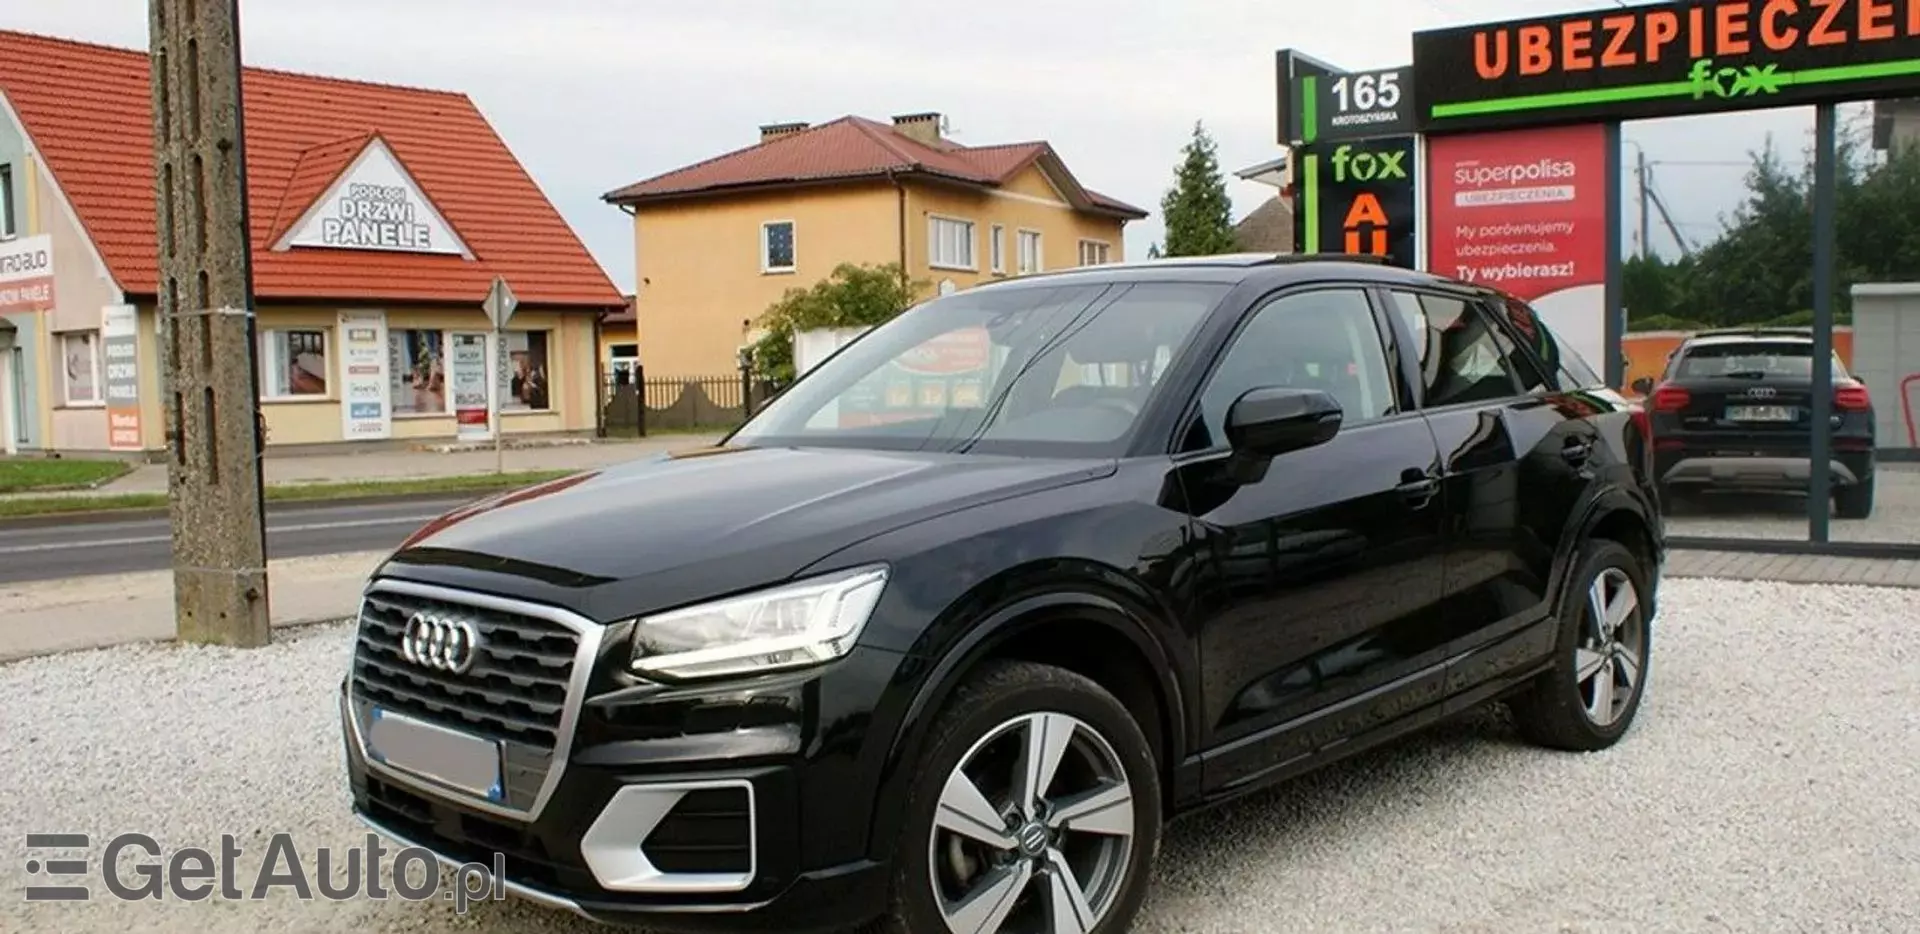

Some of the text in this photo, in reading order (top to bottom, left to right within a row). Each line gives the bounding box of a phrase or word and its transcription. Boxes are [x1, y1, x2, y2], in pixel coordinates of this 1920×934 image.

[1332, 72, 1400, 111] 165
[1689, 59, 1779, 99] fox
[1332, 145, 1407, 182] fox
[1455, 159, 1575, 187] superpolisa
[341, 198, 414, 221] DRZWI
[323, 218, 431, 248] PANELE
[1456, 221, 1575, 240] My porównujemy
[1457, 261, 1575, 282] Ty wybierasz!
